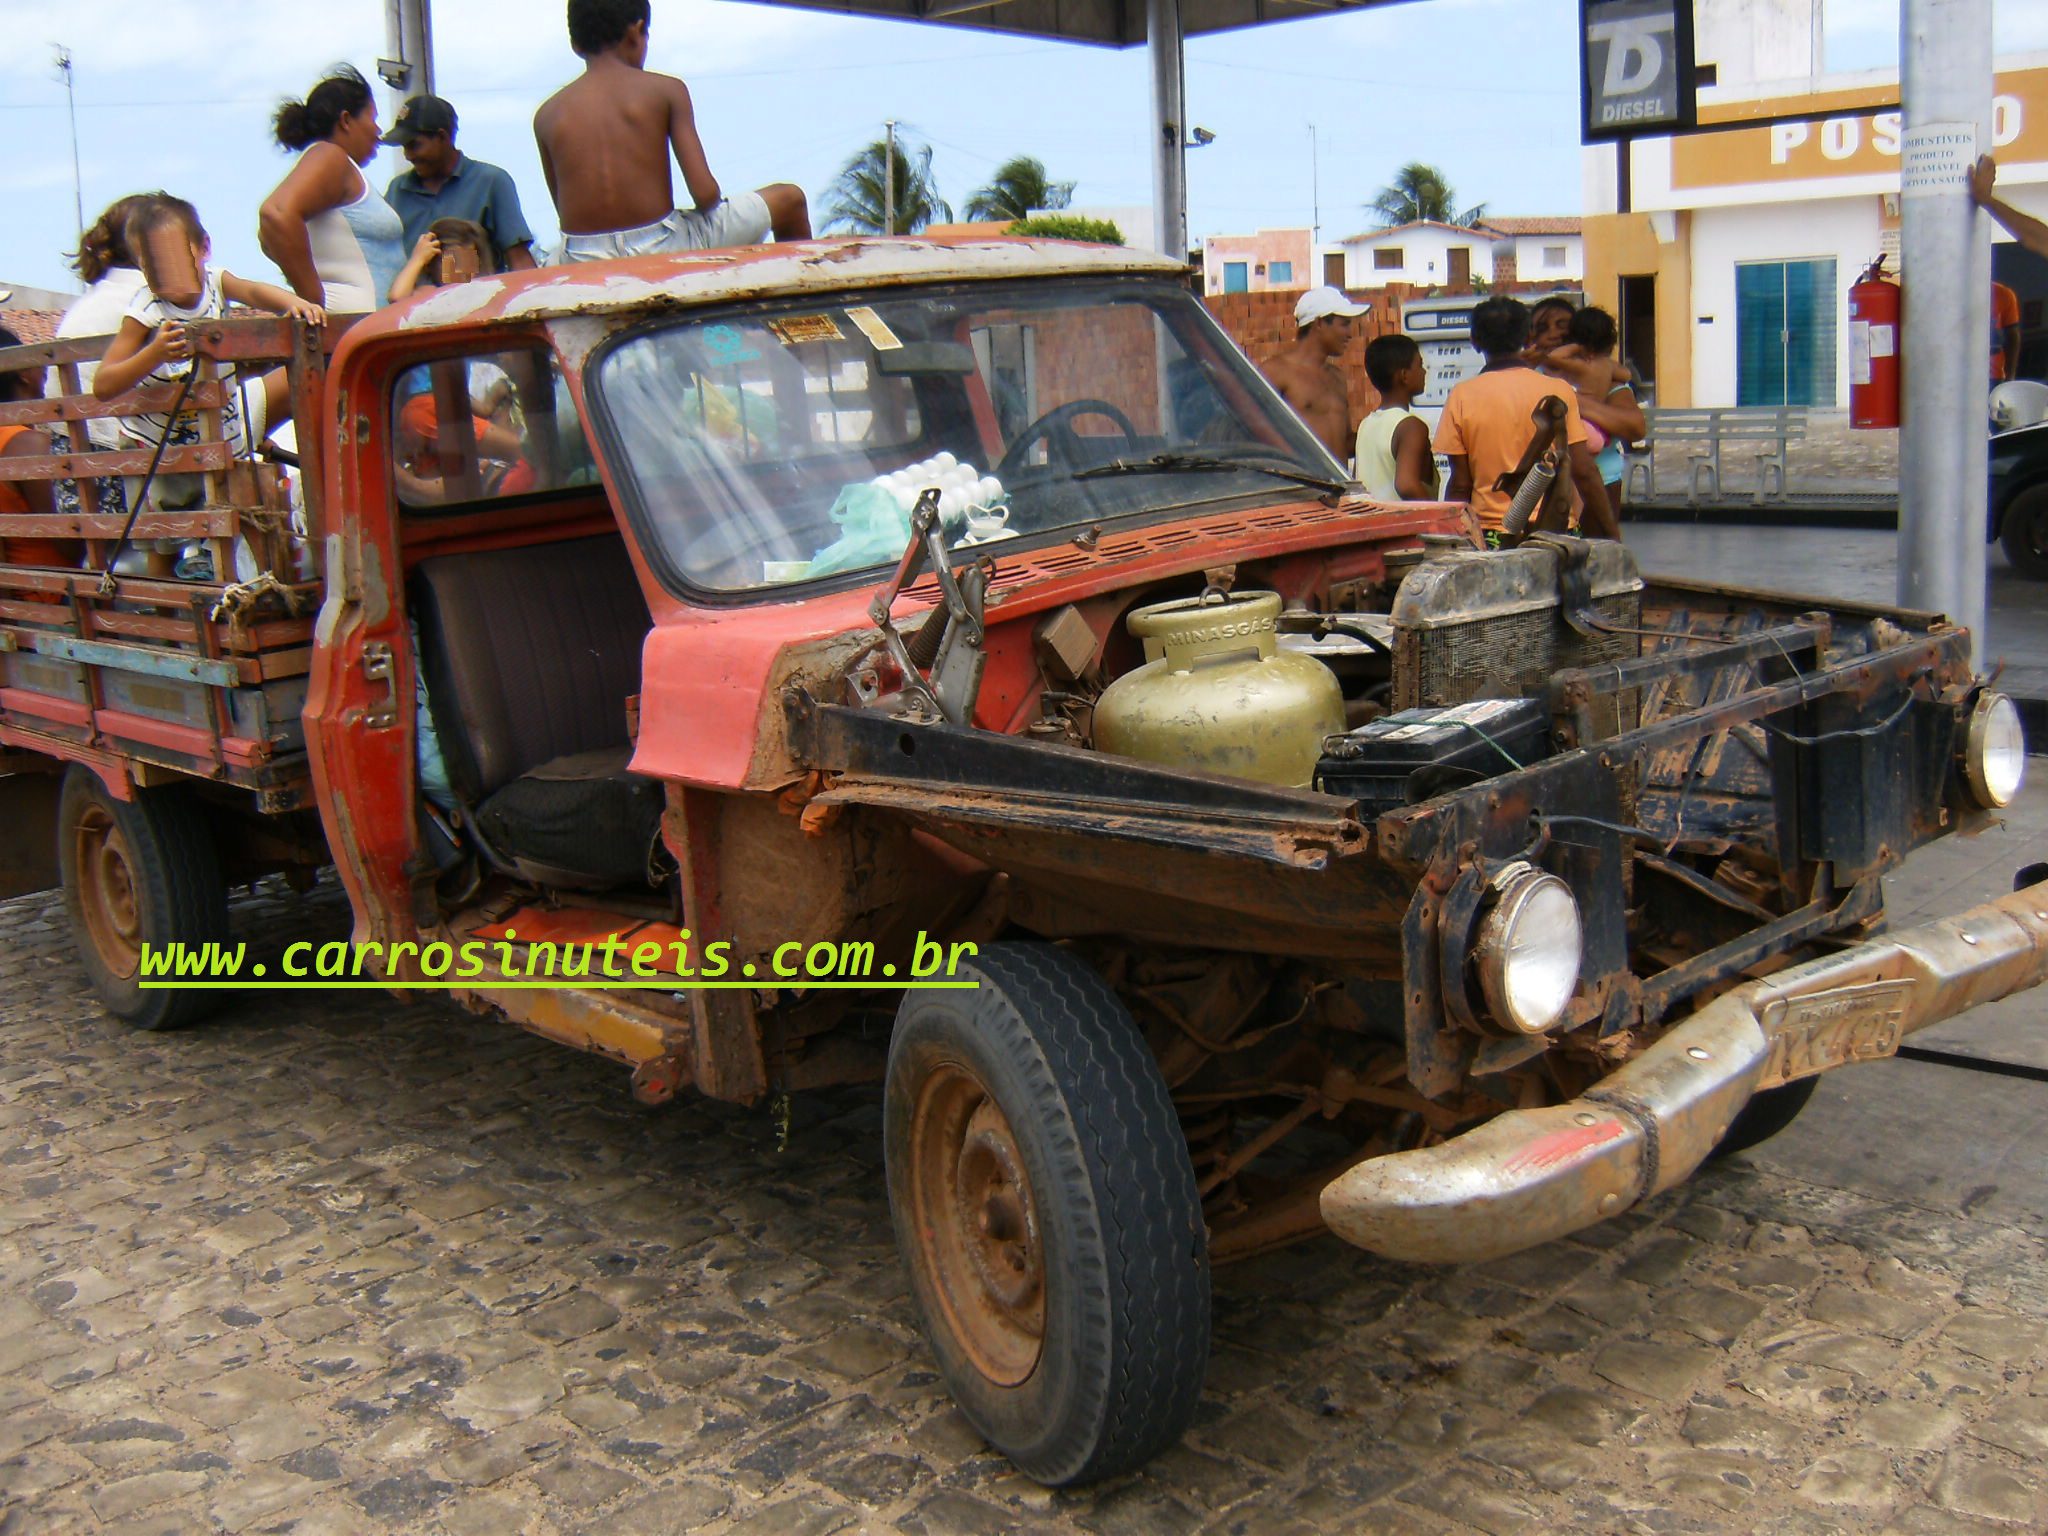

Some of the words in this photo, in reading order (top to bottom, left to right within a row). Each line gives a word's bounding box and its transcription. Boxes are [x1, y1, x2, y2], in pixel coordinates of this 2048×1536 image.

[1602, 98, 1664, 121] DIESEL
[1771, 95, 2021, 165] POSO
[1903, 133, 1972, 149] OMBUSTÍVEIS
[1910, 150, 1954, 161] PRODUTO
[1903, 178, 1928, 187] OCIVO
[1441, 316, 1469, 325] DIESEL
[1166, 615, 1273, 647] MINASGÁS
